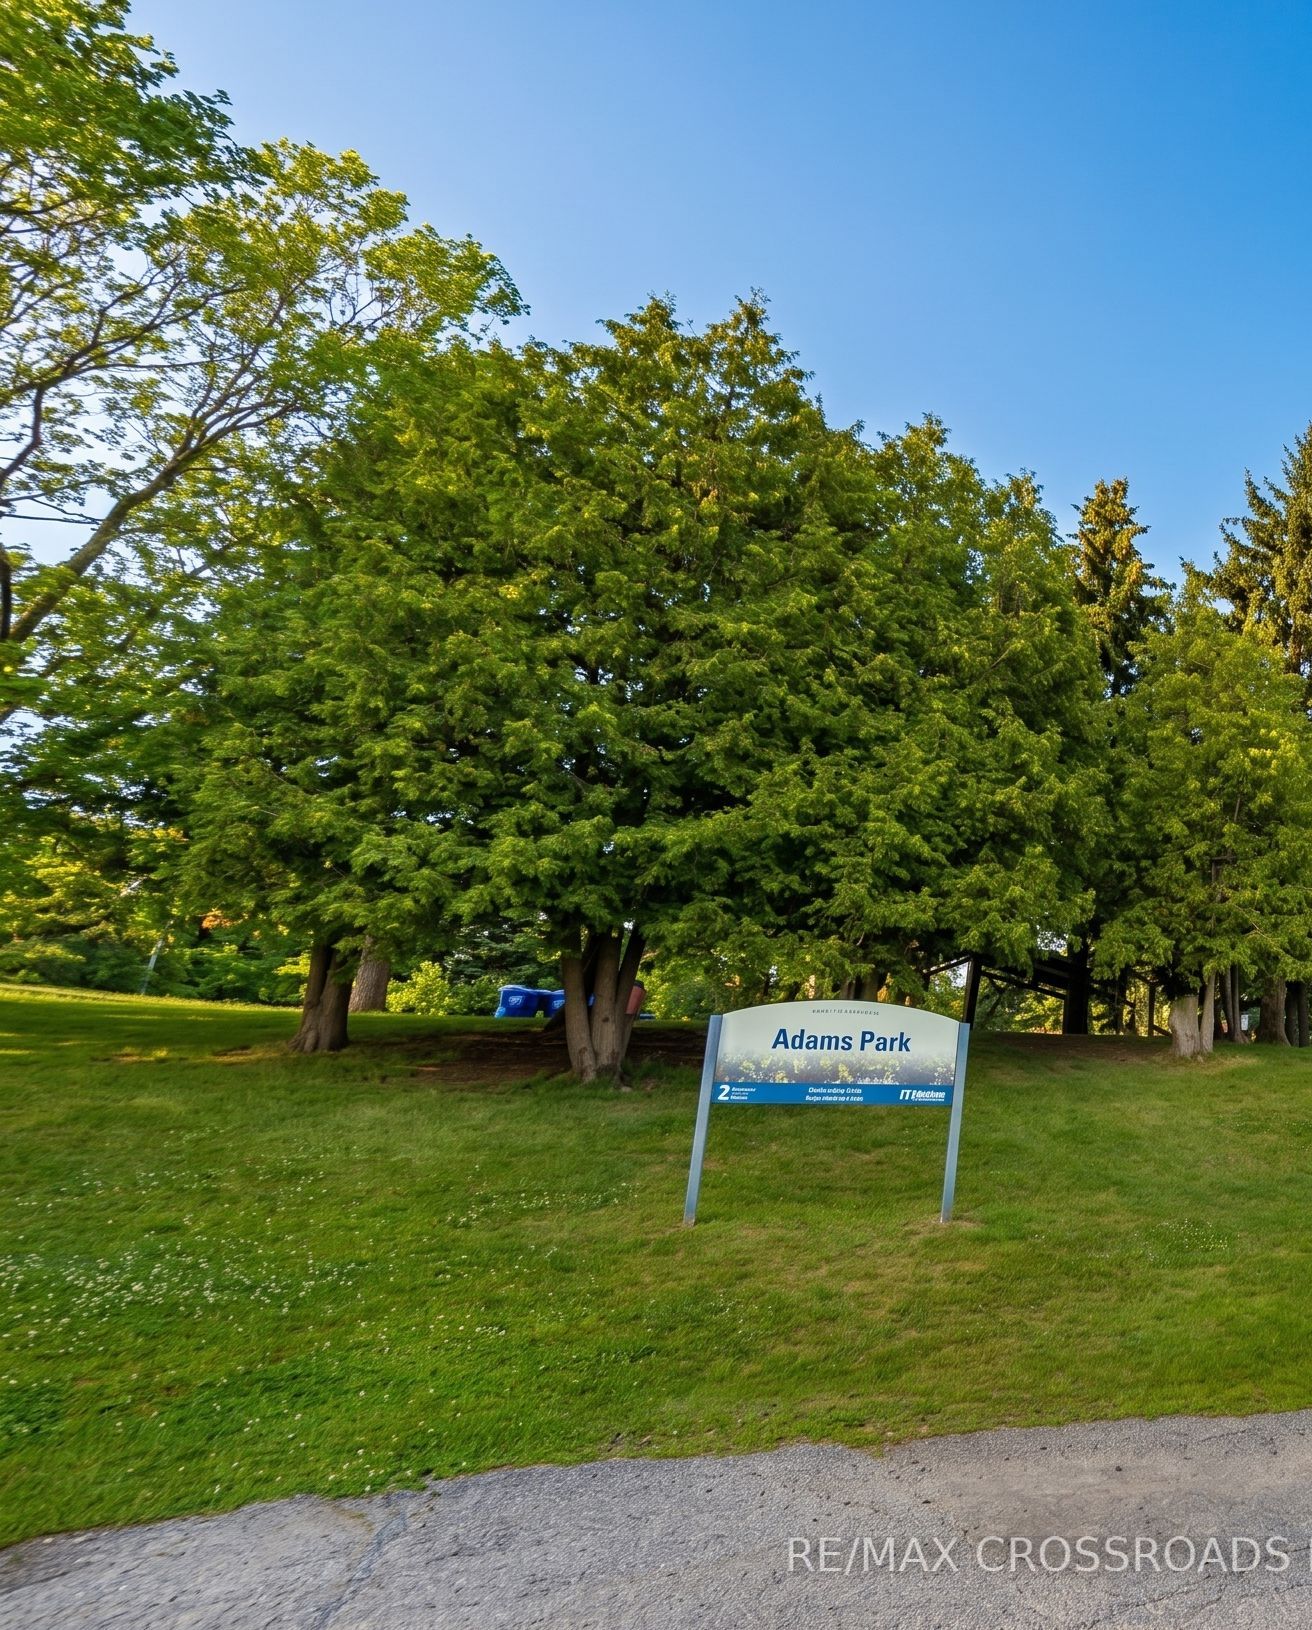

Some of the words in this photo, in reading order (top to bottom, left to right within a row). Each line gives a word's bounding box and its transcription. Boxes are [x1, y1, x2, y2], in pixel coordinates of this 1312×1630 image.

[772, 1028, 853, 1052] Adams
[860, 1030, 911, 1053] Park
[717, 1084, 730, 1101] 2
